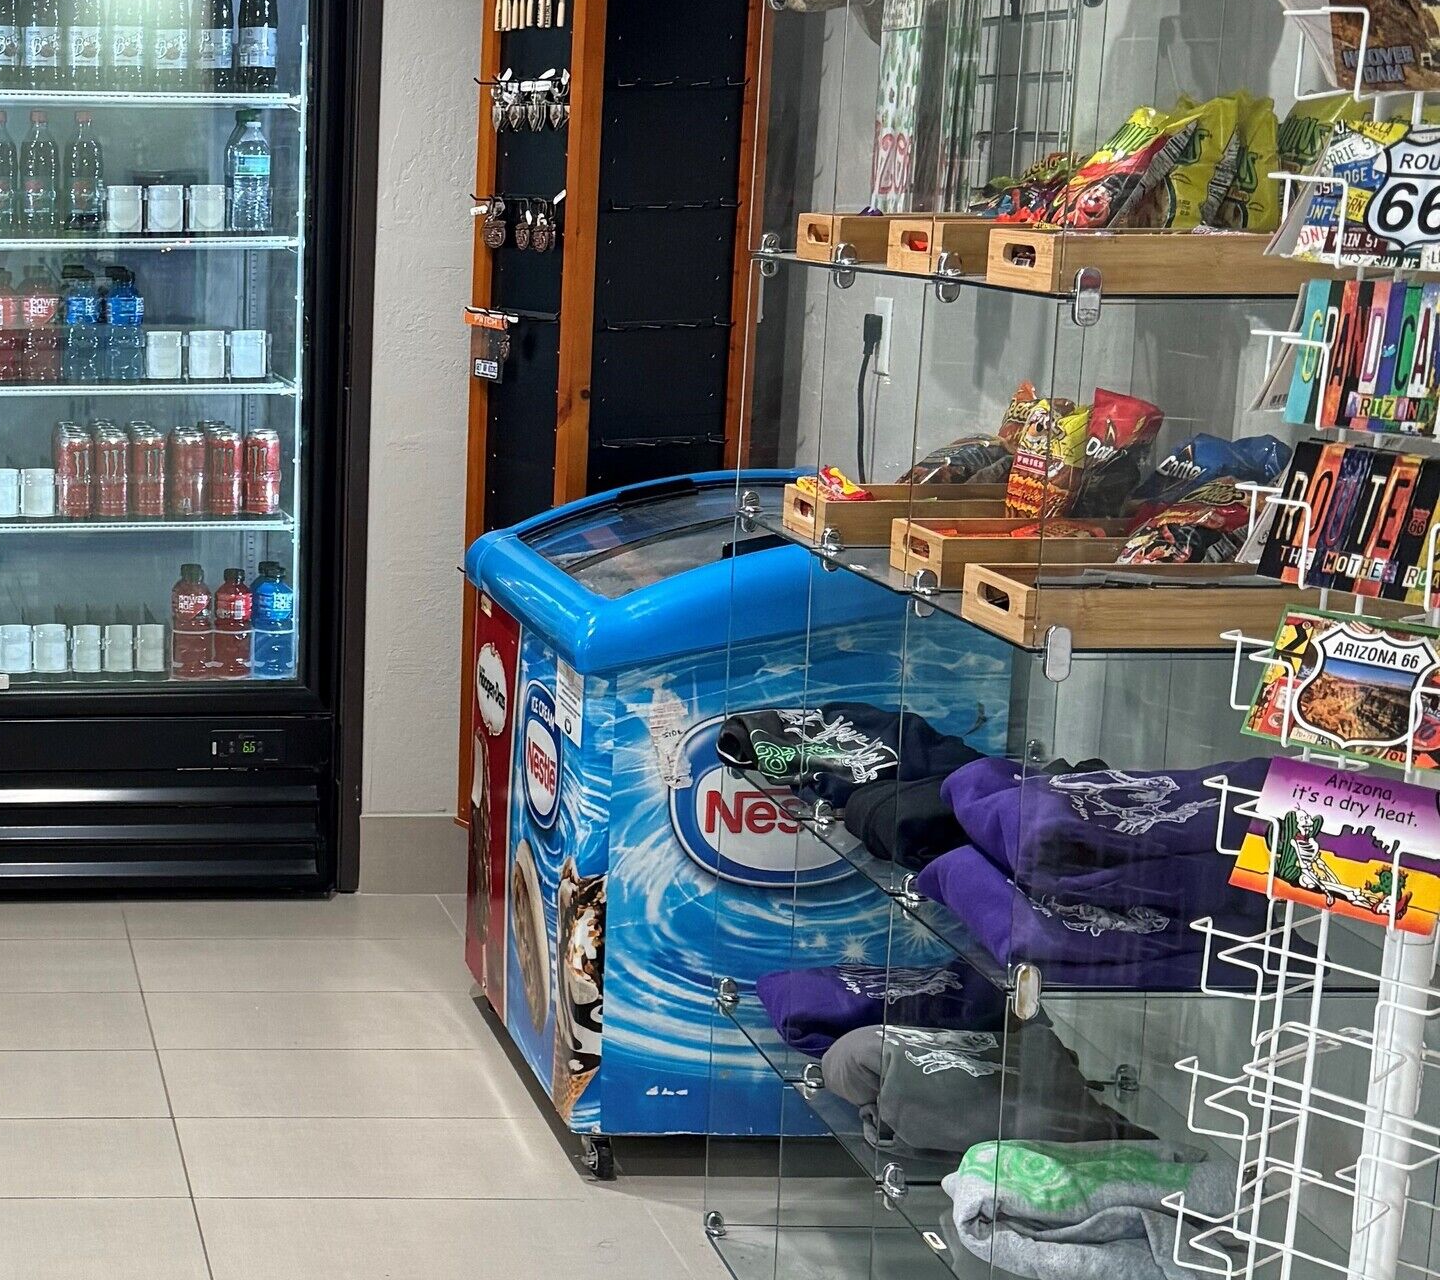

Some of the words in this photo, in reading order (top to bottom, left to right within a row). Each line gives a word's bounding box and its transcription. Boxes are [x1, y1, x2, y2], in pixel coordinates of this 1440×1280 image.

[1343, 45, 1415, 68] HOVER
[1362, 63, 1407, 83] DAM
[1301, 305, 1386, 387] GRAND
[1346, 396, 1431, 421] ARIZONA
[1016, 455, 1045, 468] FRIES
[1276, 468, 1412, 557] ROUTE
[1323, 551, 1398, 583] MOTHER
[1333, 641, 1396, 666] ARIZONA
[1400, 652, 1420, 669] 66
[531, 696, 539, 714] ICE
[538, 698, 556, 733] CREAM
[1324, 773, 1397, 804] Arizona,
[1292, 783, 1320, 803] it's
[1323, 795, 1334, 807] a
[1339, 795, 1369, 818] dry
[1374, 802, 1418, 827] heat.
